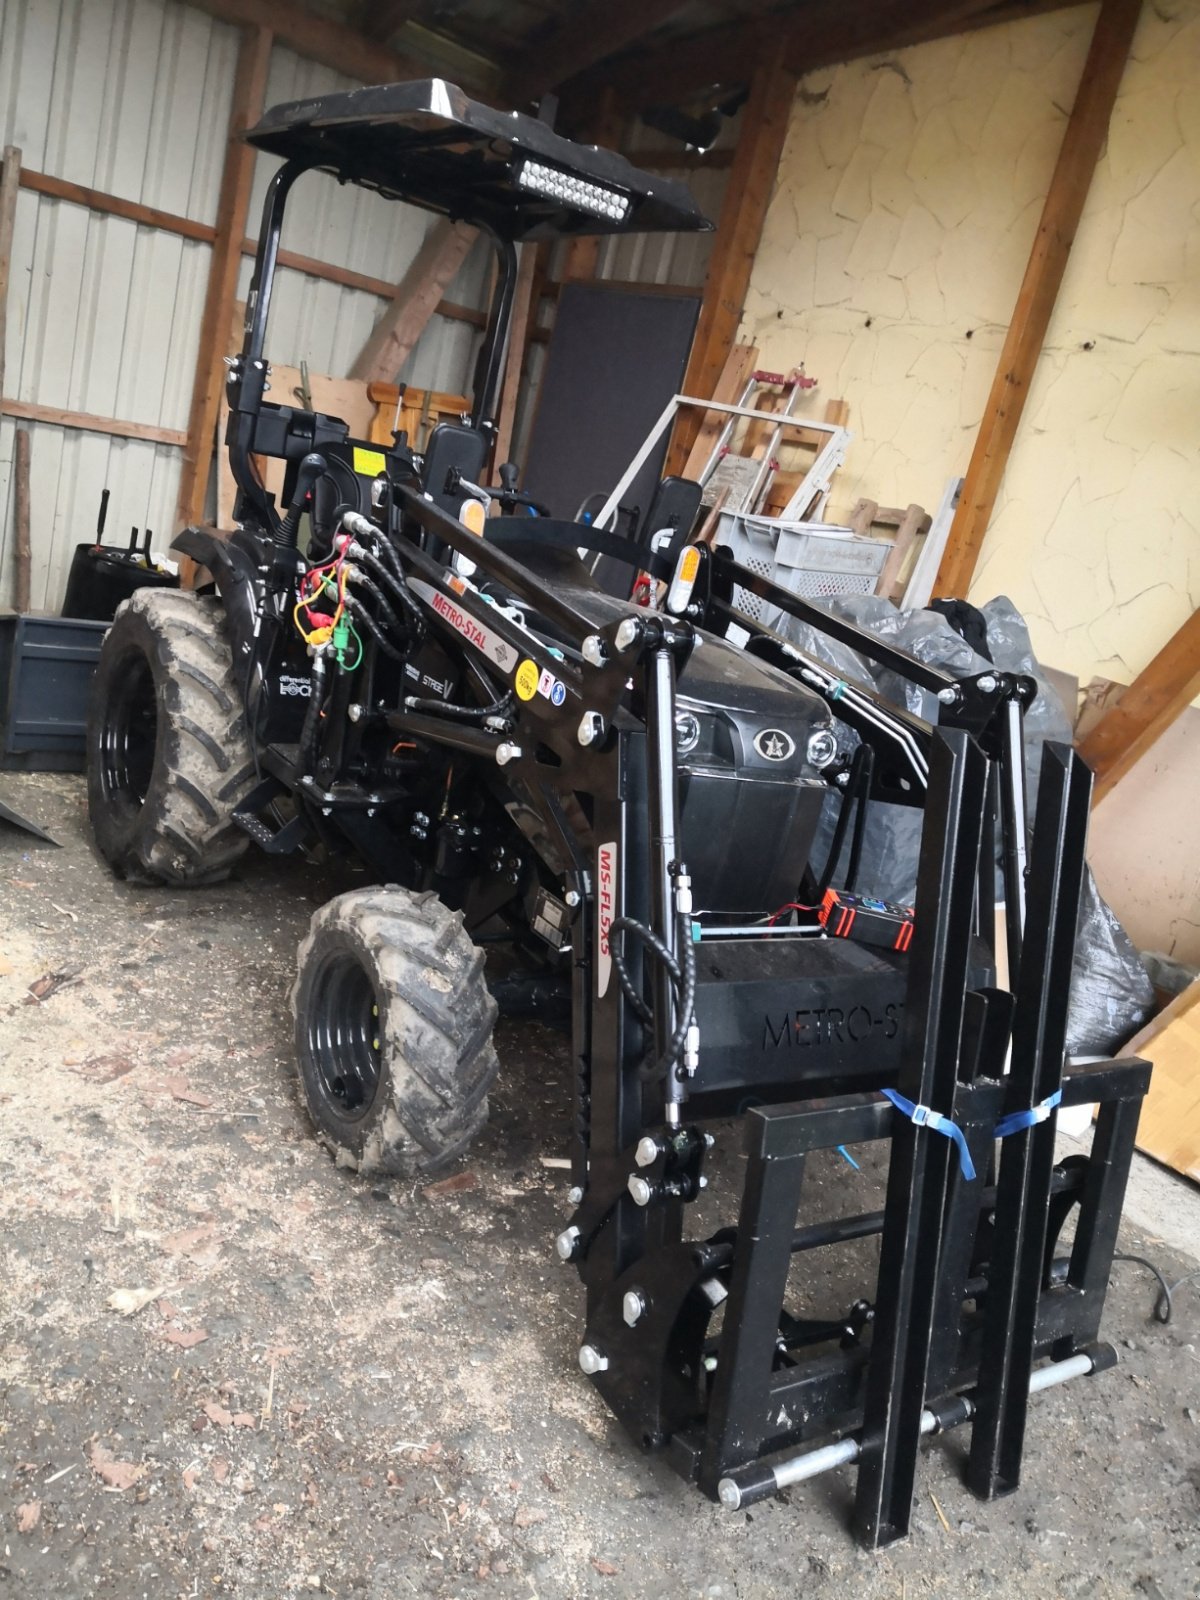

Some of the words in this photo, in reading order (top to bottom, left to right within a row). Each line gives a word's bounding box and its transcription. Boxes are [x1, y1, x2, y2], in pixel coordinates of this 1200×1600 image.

[432, 593, 487, 650] METRO-STAL
[600, 851, 611, 956] MS-FL5X5
[762, 1002, 904, 1051] METRO-S
